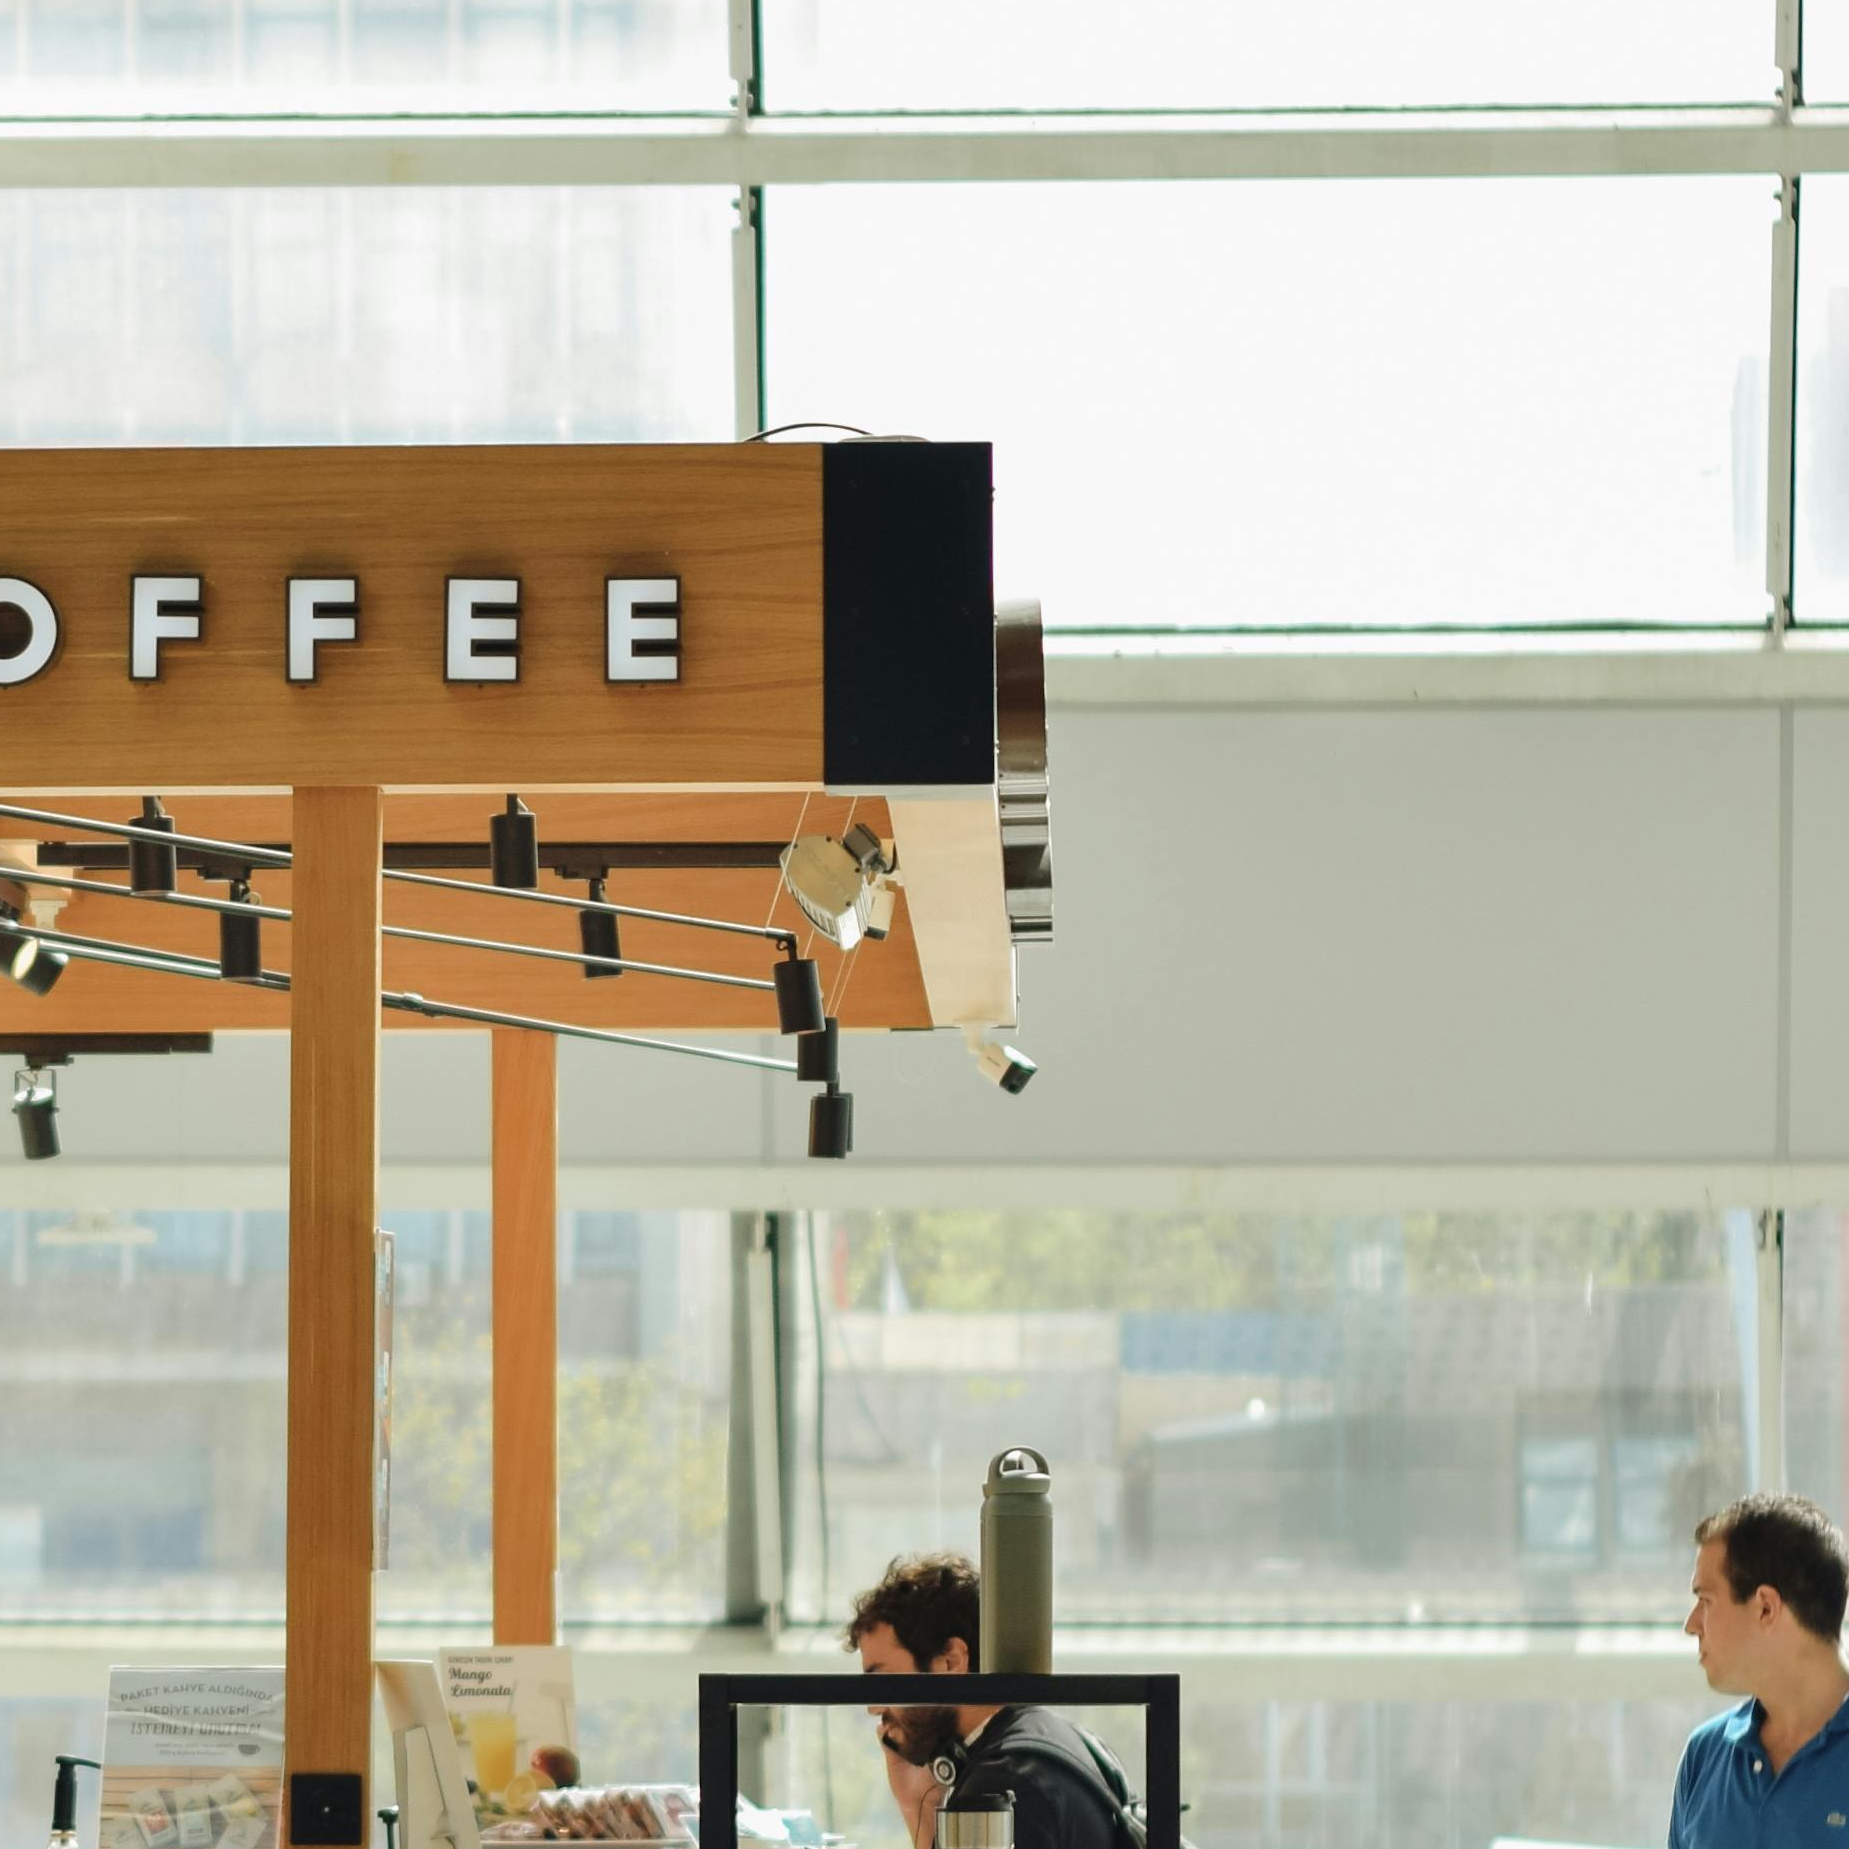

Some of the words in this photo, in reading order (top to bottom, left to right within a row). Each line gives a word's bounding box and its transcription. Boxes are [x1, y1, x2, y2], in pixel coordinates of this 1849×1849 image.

[449, 1667, 492, 1684] Mango
[120, 1686, 160, 1702] PAKET
[163, 1683, 205, 1695] KAHVE
[451, 1684, 512, 1697] Limonata
[143, 1703, 190, 1716] HEDİYE
[193, 1704, 249, 1716] KAHVENİ
